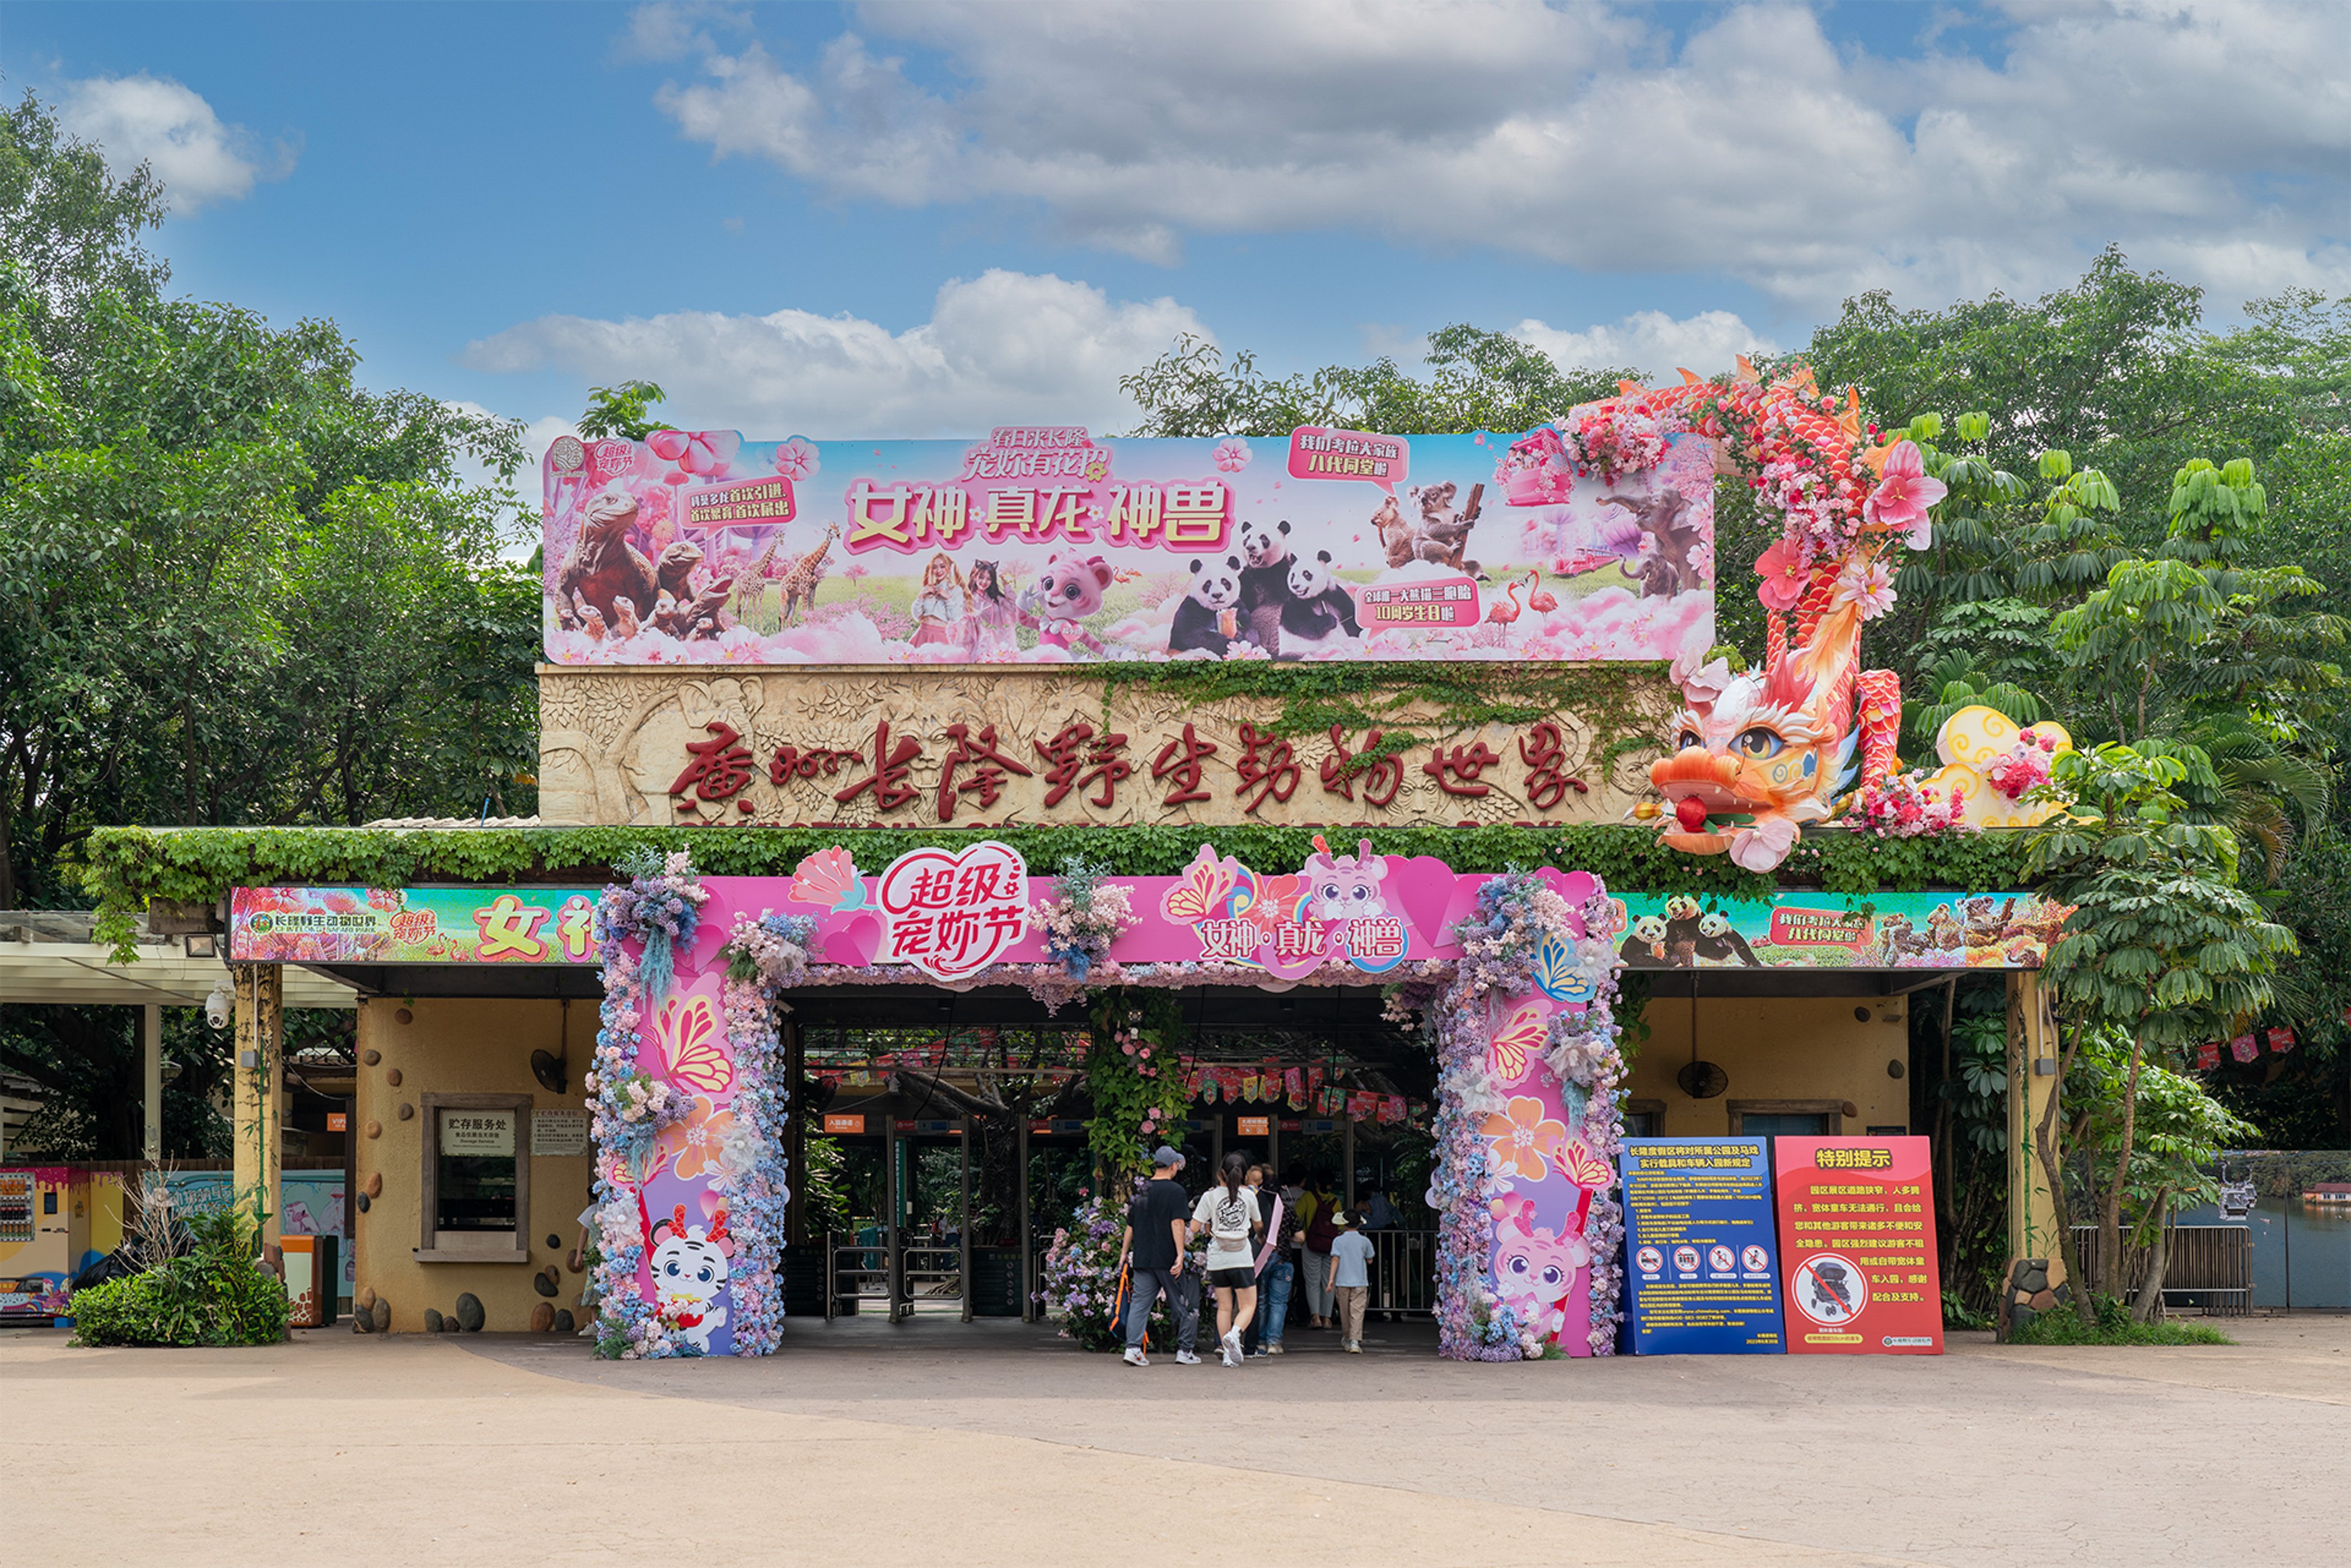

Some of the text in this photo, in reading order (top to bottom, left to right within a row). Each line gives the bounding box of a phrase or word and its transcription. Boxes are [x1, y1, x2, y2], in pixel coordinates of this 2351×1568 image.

[994, 429, 1086, 448] 春日来长隆
[1300, 434, 1399, 459] 我们考拉大家族
[1308, 454, 1388, 476] 八代同堂啦
[1365, 584, 1472, 603] 全球唯一大熊猫三胞胎
[1375, 604, 1455, 622] 10周岁生日啦
[910, 863, 1008, 909] 超级
[275, 915, 377, 927] 长隆野生动物世界
[448, 1119, 506, 1130] 贮存服务处
[1816, 1149, 1891, 1168] 特别提示
[1795, 1221, 1923, 1231] 您和其他游客带来诸多不便和安
[1860, 1256, 1925, 1266] 用或自带宽体童
[1871, 1274, 1927, 1284] 车入园，感谢
[1872, 1292, 1924, 1302] 配合及支持。
